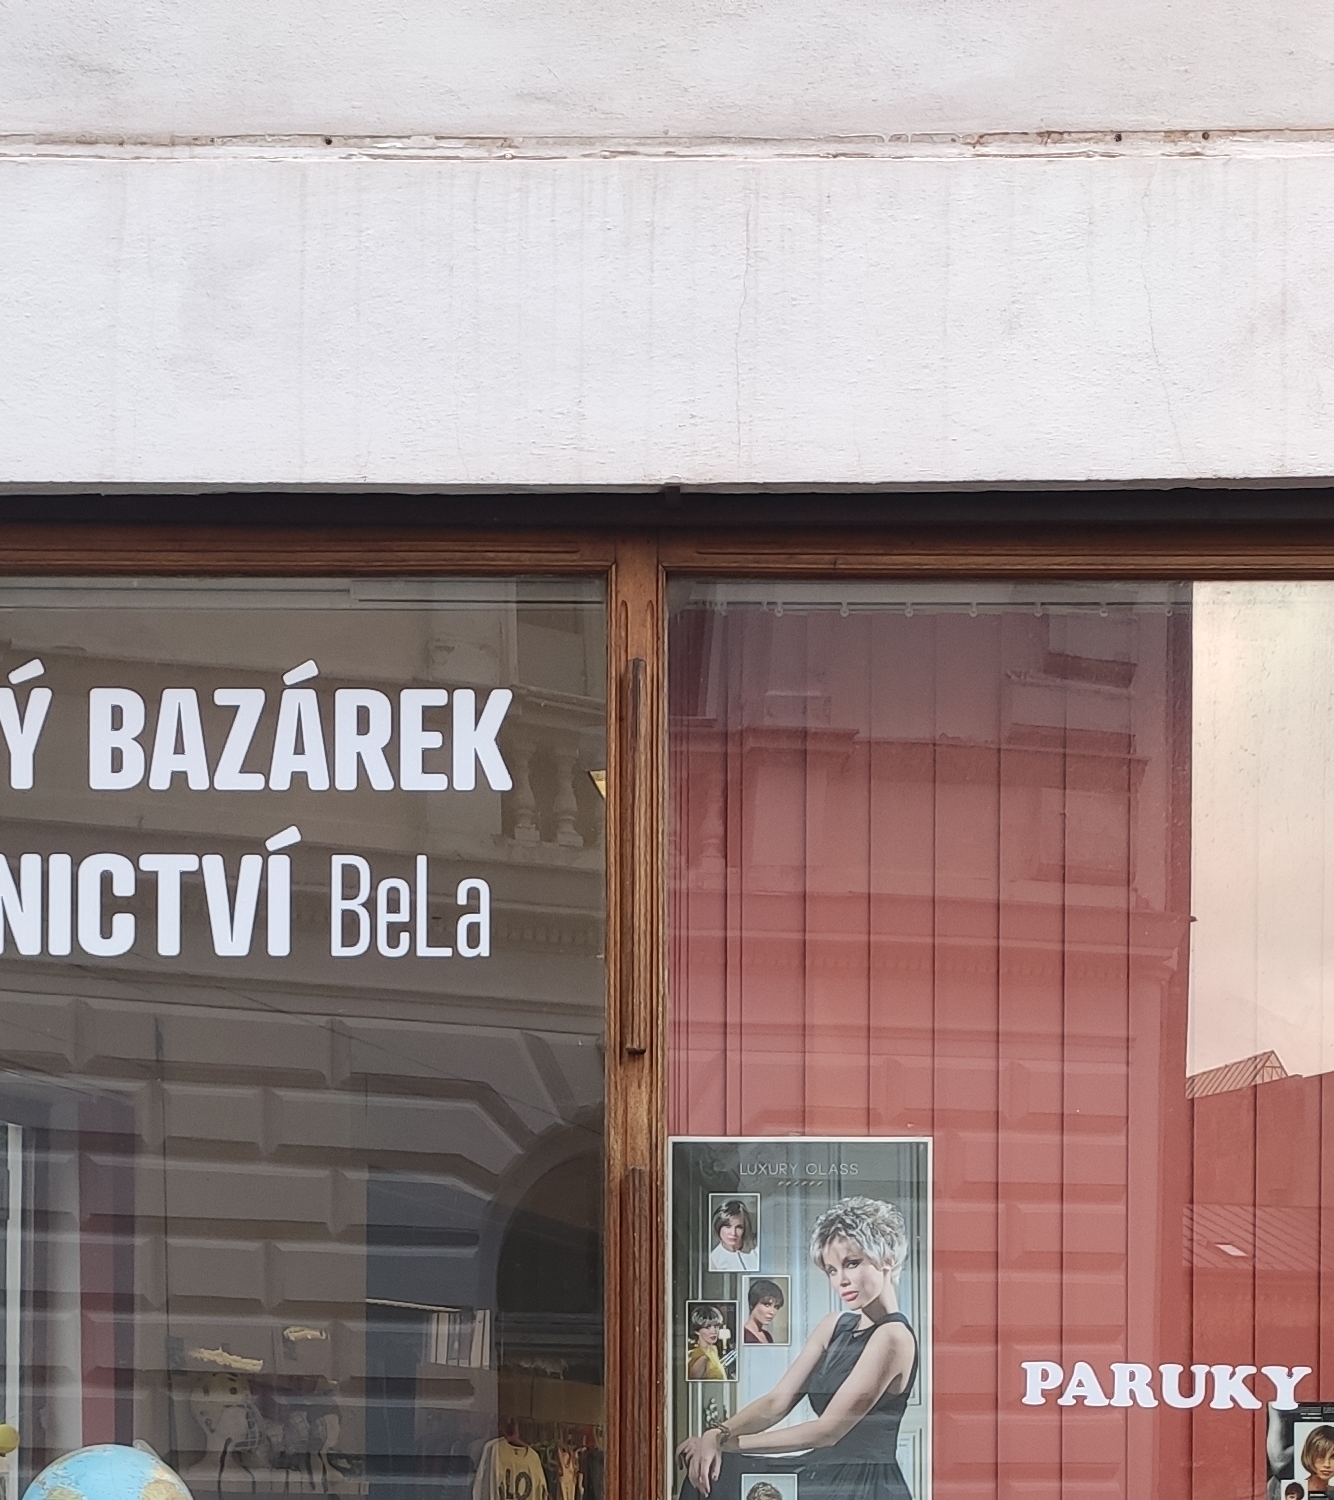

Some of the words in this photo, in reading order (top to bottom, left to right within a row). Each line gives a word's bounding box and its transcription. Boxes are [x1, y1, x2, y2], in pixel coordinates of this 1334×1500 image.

[87, 658, 513, 792] BAZÁREK
[329, 854, 491, 959] BeLa
[739, 1163, 798, 1175] LUXURY
[805, 1163, 859, 1175] CLASS
[1020, 1361, 1313, 1411] PARUKY
